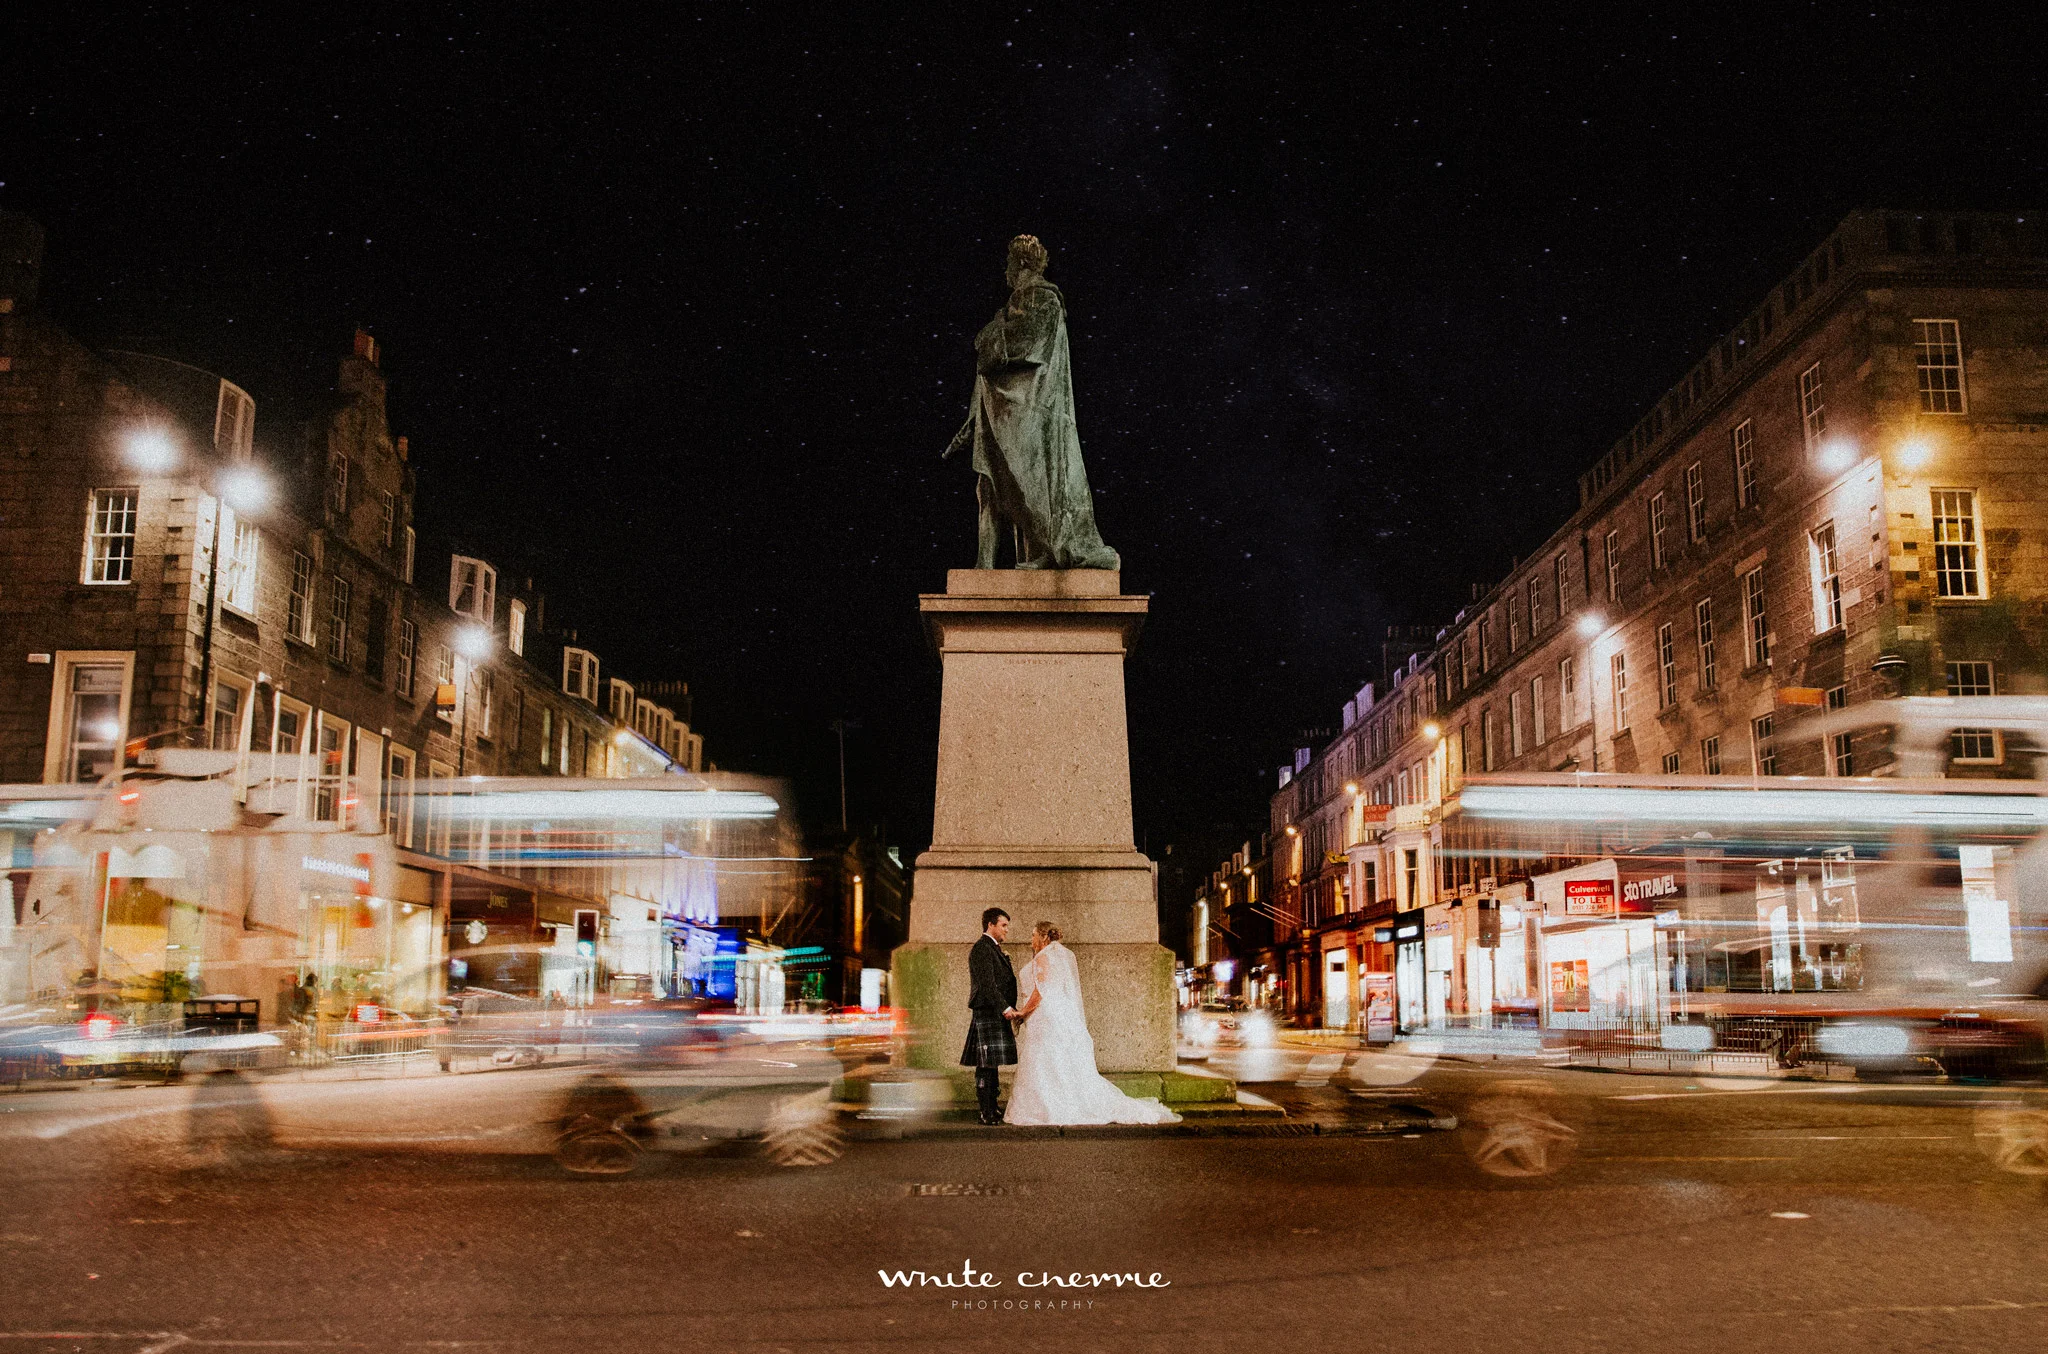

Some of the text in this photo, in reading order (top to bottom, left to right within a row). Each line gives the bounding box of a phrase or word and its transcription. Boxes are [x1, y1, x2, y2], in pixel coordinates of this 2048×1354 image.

[1568, 885, 1611, 894] Culverwell
[1639, 874, 1679, 899] TRAVEL
[1590, 896, 1608, 904] LET
